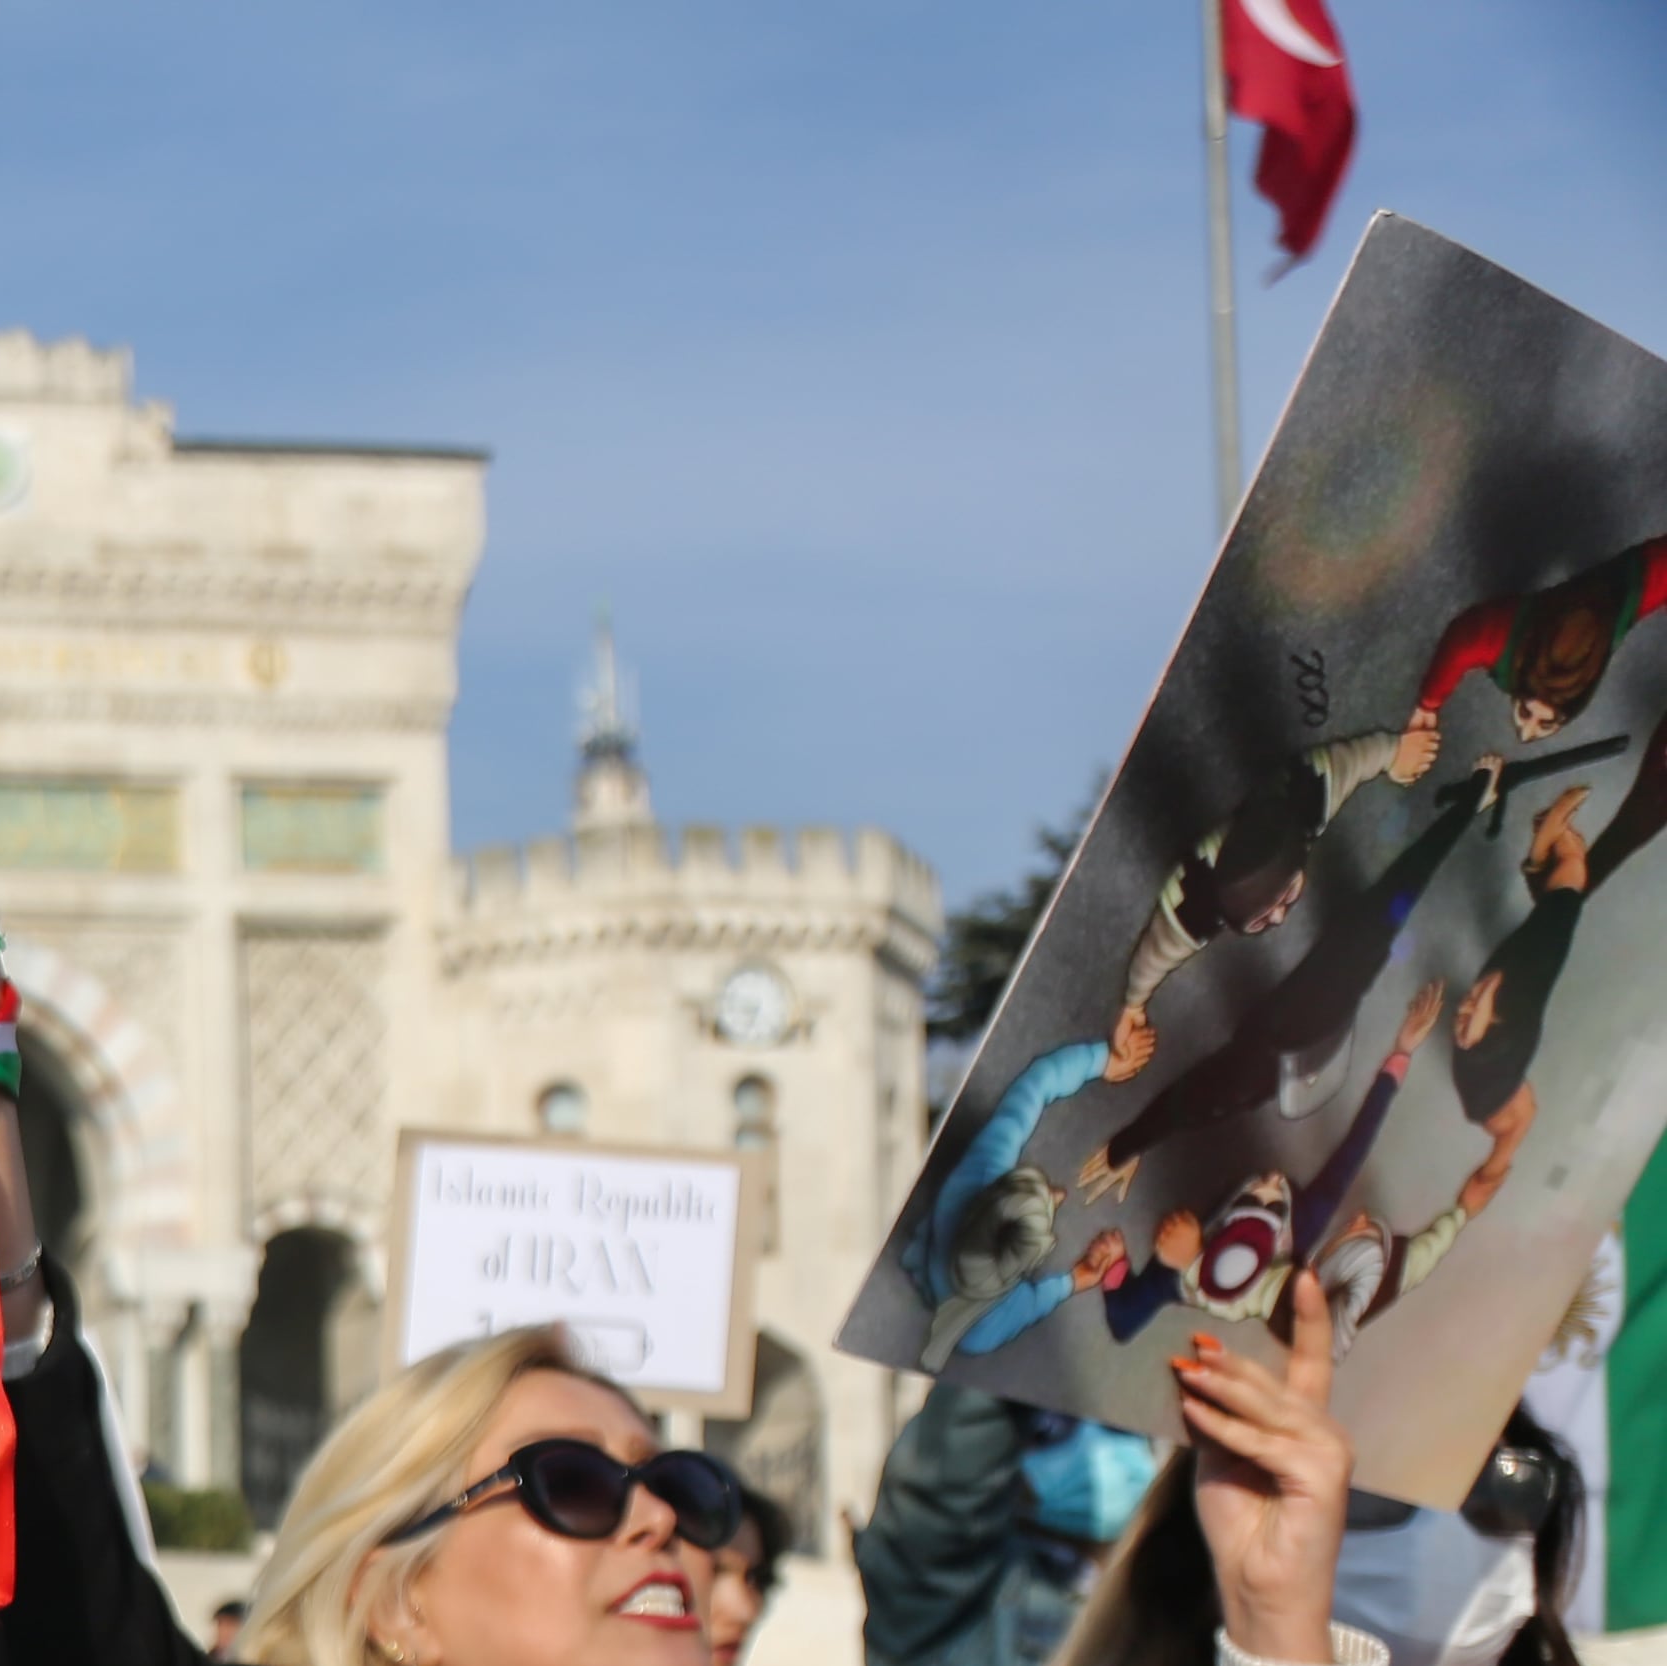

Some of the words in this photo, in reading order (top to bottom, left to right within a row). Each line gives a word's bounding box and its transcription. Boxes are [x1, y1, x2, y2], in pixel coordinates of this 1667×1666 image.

[431, 1160, 553, 1212] Islamic
[571, 1170, 719, 1234] Republic
[481, 1234, 513, 1286] of
[525, 1236, 659, 1298] IRAN
